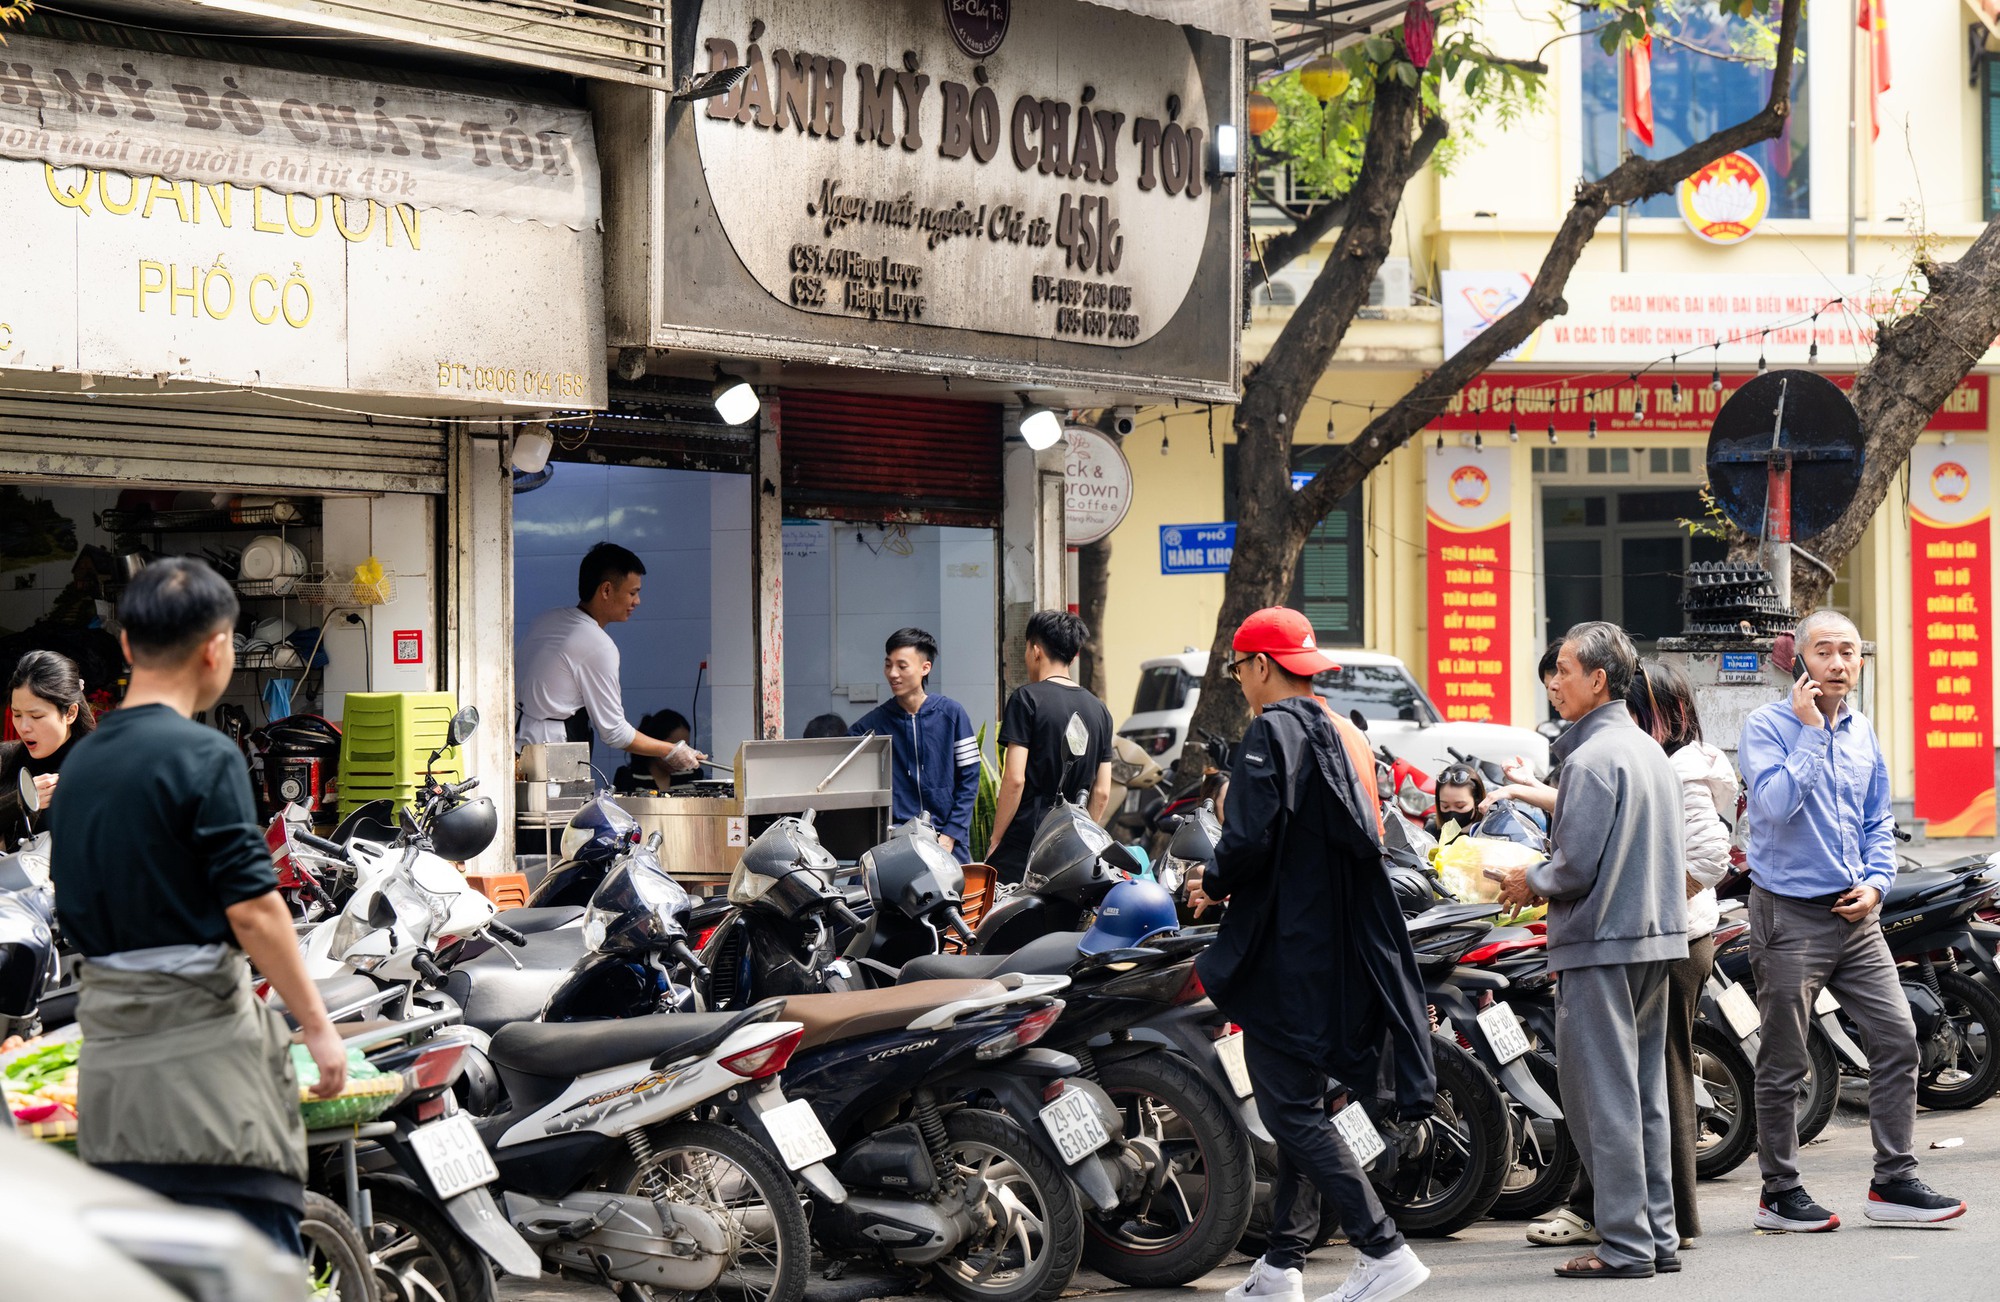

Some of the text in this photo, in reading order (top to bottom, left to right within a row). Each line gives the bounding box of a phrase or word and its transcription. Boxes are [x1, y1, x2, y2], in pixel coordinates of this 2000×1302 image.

[171, 76, 264, 136] BÒ
[279, 97, 445, 160] CHÁY
[704, 19, 1203, 198] BÁNH MỲ BÒ CHÁY TỎI
[357, 166, 417, 197] 45k
[1055, 192, 1123, 276] 45k
[139, 252, 314, 328] PHỐ CỔ
[474, 366, 517, 394] 0906
[523, 369, 552, 396] 014
[555, 372, 585, 398] 158
[1515, 387, 1556, 415] QUAN
[1583, 387, 1614, 413] BAN
[1093, 465, 1104, 479] &
[1066, 497, 1118, 511] Coffee
[1197, 527, 1226, 541] PHỐ
[1168, 545, 1204, 567] HÀNG
[866, 1037, 939, 1062] VISION
[1059, 1118, 1104, 1159] 638.64
[432, 1150, 493, 1191] 800.02
